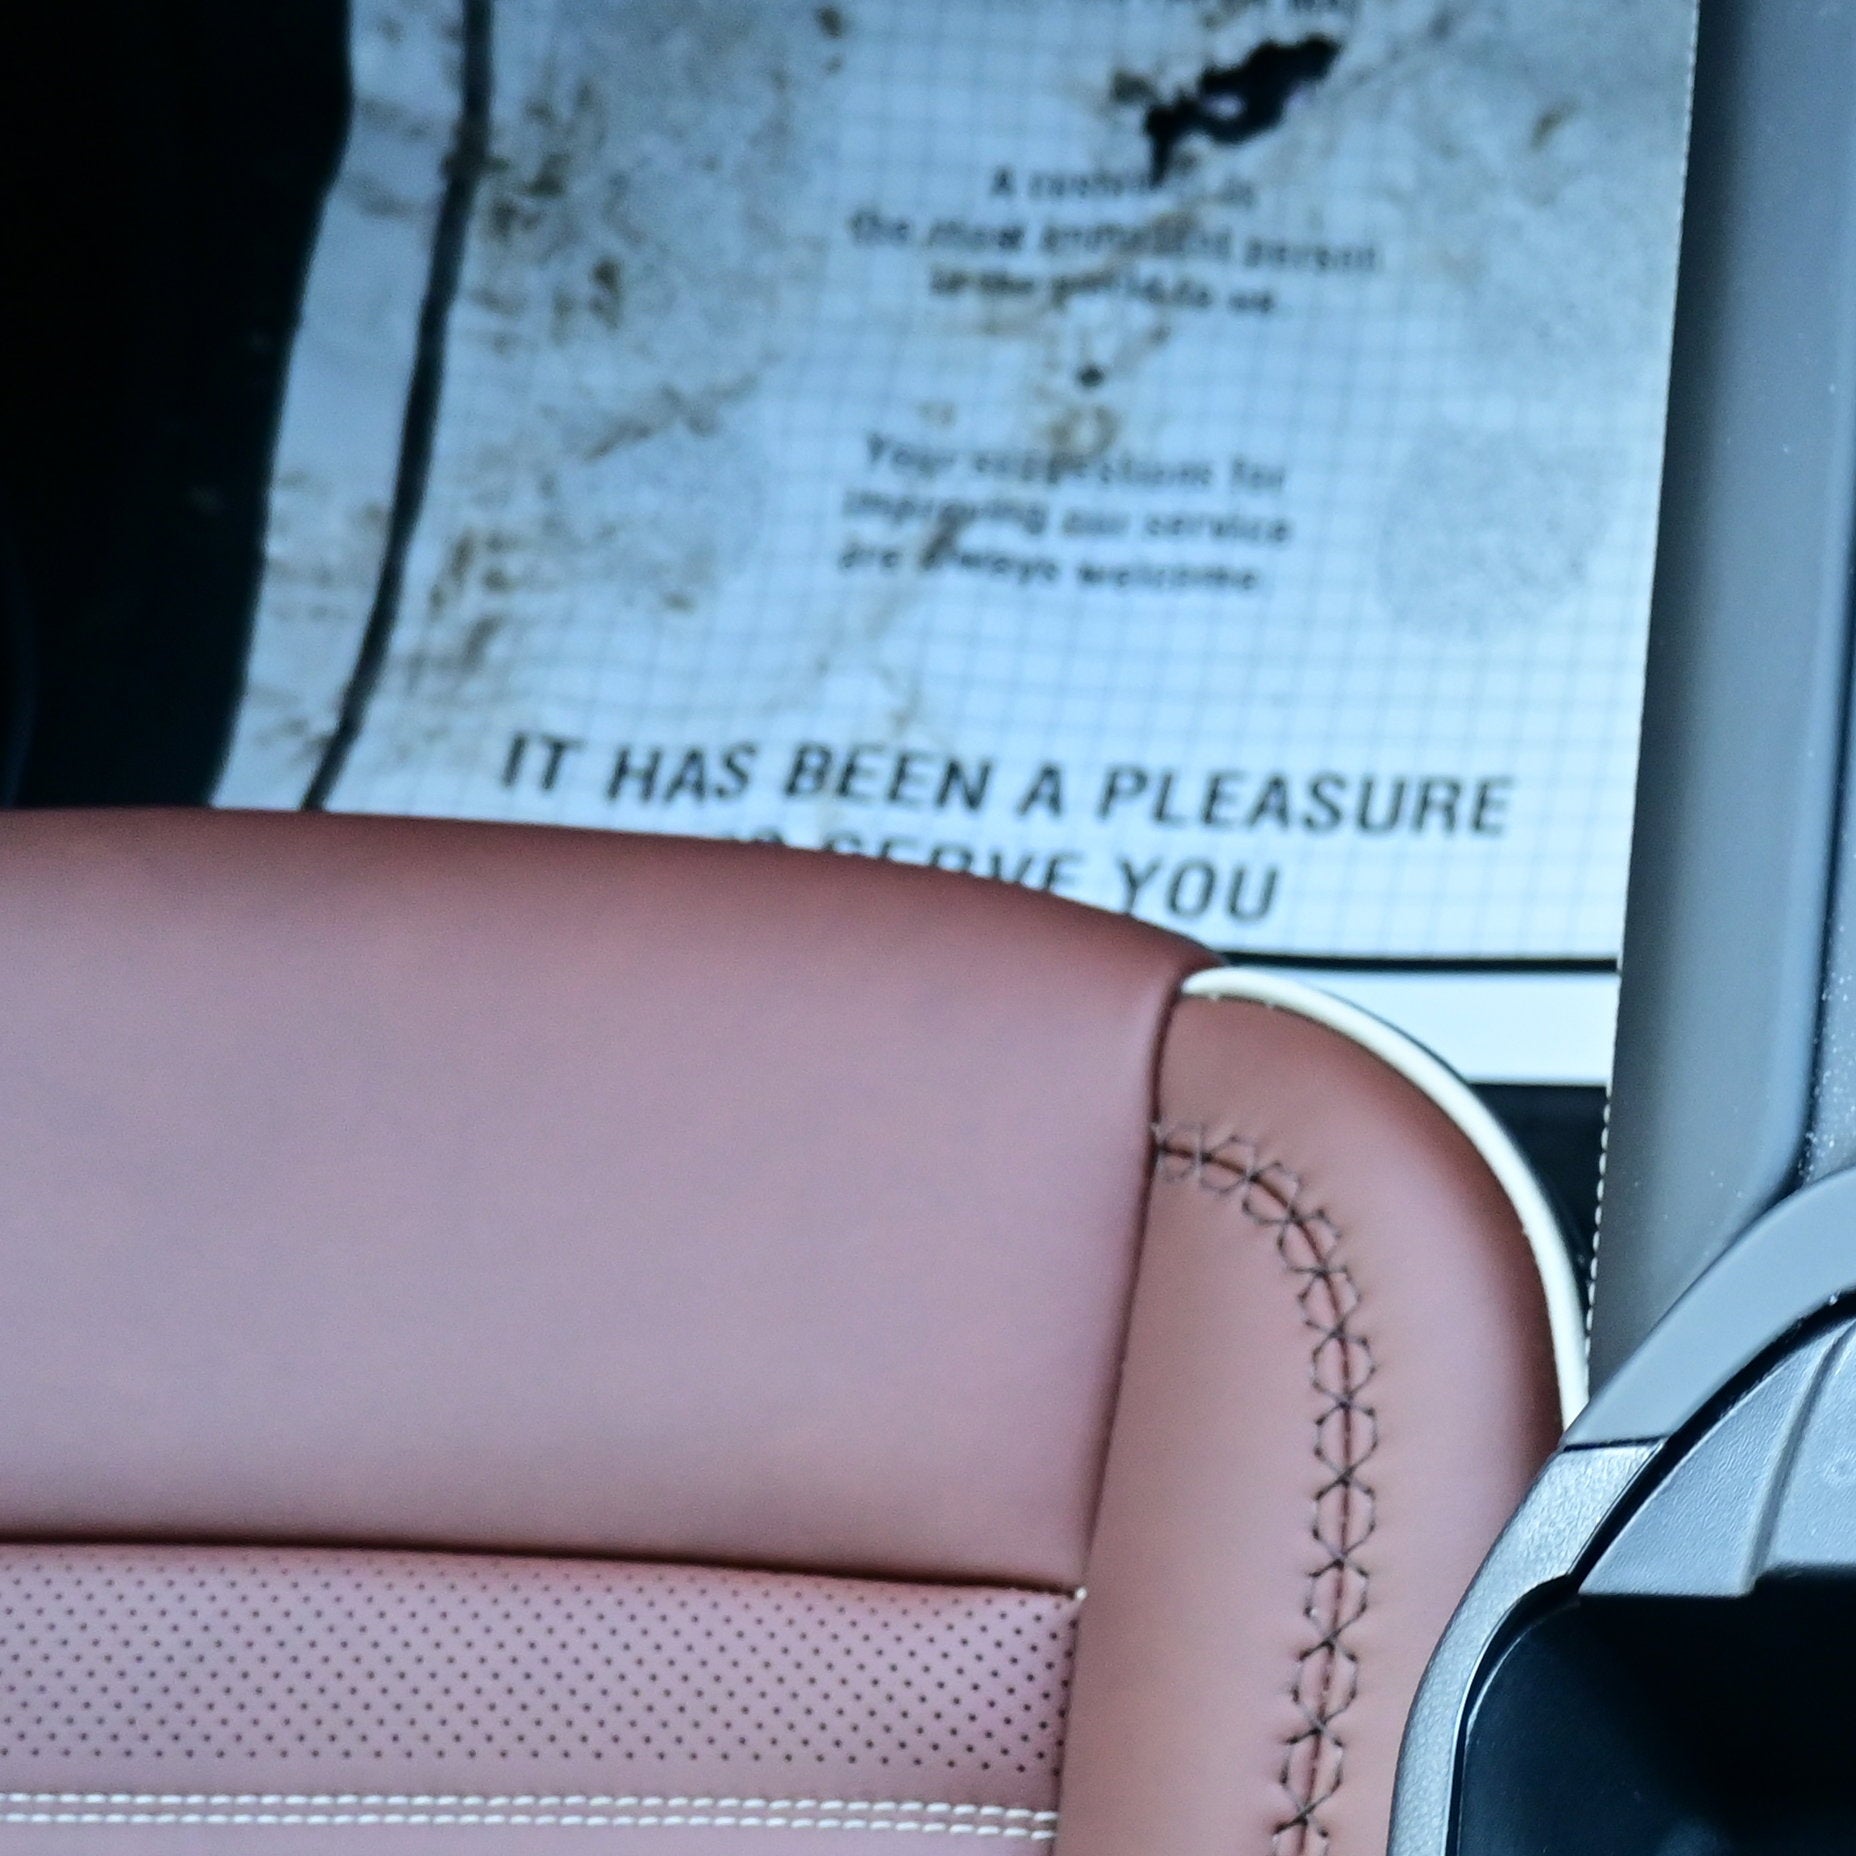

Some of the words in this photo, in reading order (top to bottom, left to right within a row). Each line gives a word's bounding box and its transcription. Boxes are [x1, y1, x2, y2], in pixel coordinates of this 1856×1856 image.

[503, 731, 585, 791] IT
[606, 741, 759, 802] HAS
[784, 741, 994, 812] BEEN
[1017, 762, 1066, 818] A
[1098, 764, 1517, 838] PLEASURE
[1117, 854, 1281, 924] YOU
